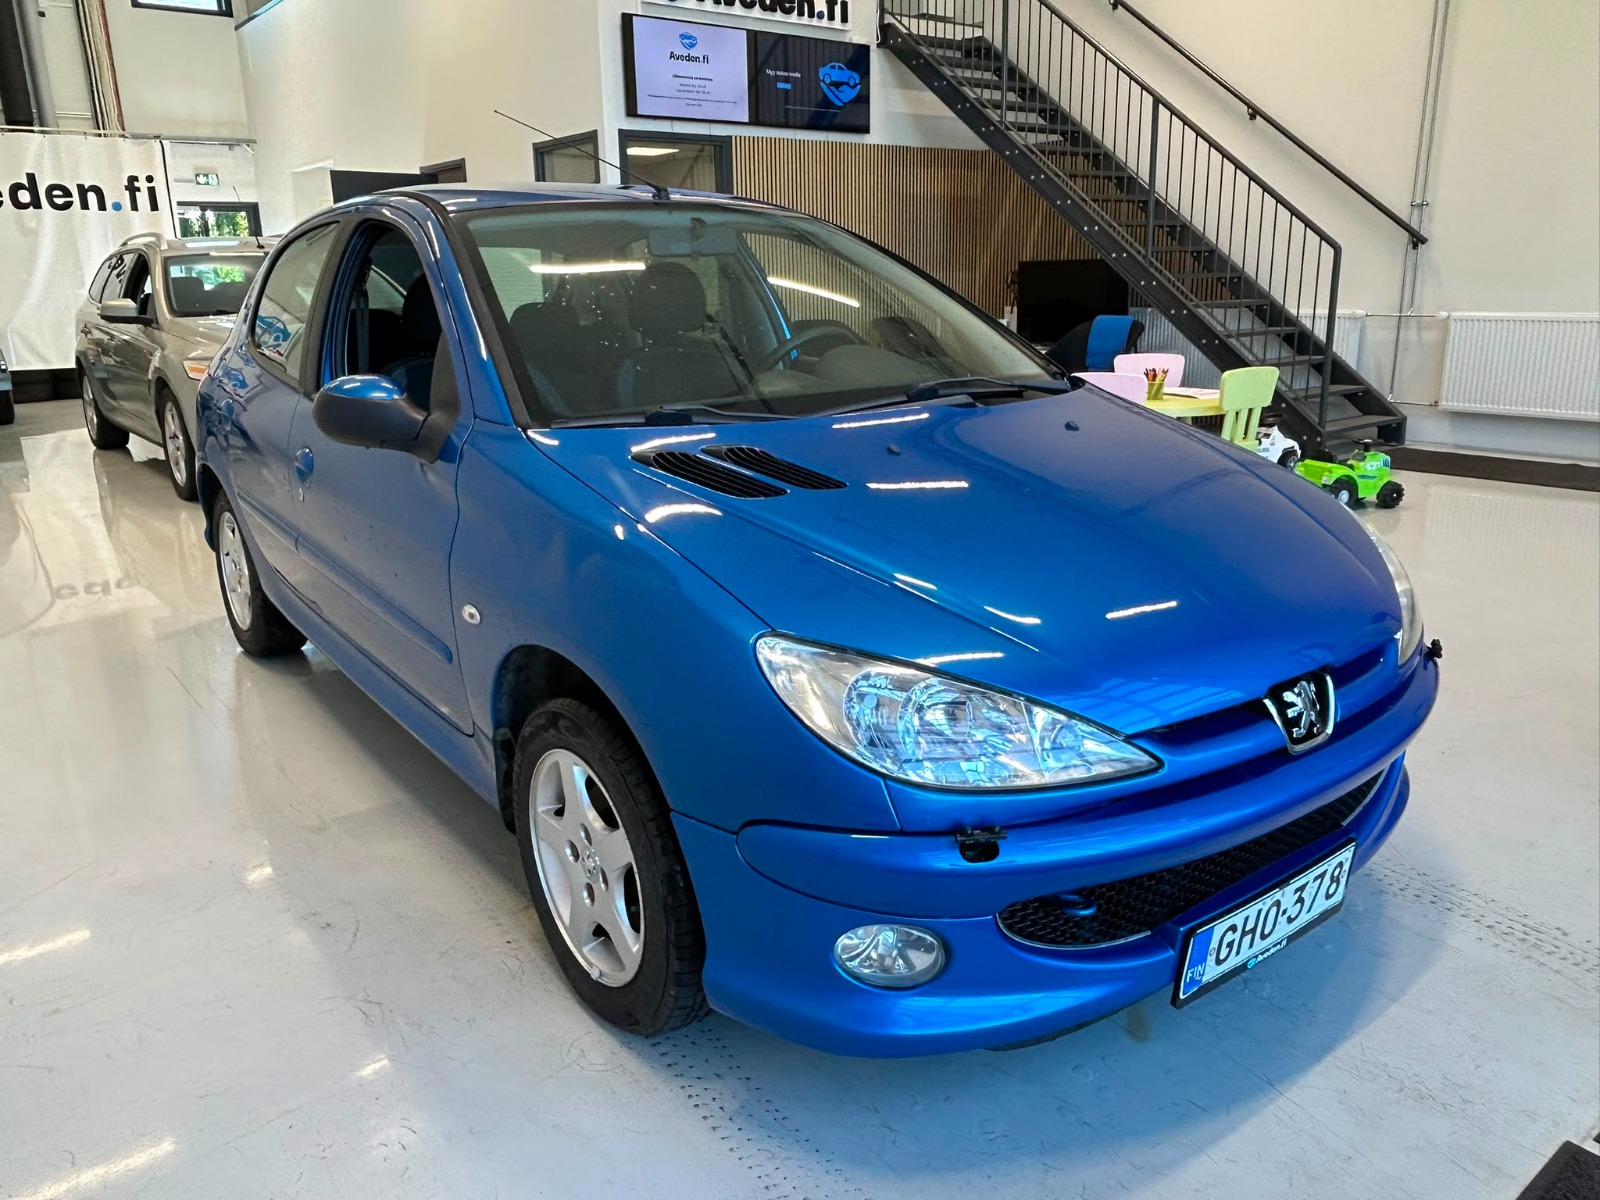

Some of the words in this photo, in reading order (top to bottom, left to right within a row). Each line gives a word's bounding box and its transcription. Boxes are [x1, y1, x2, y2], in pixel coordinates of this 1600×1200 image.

[669, 51, 709, 64] Aveden.fi
[0, 172, 159, 212] den.fi
[1215, 860, 1344, 967] GHO-378
[1186, 961, 1206, 983] FIN
